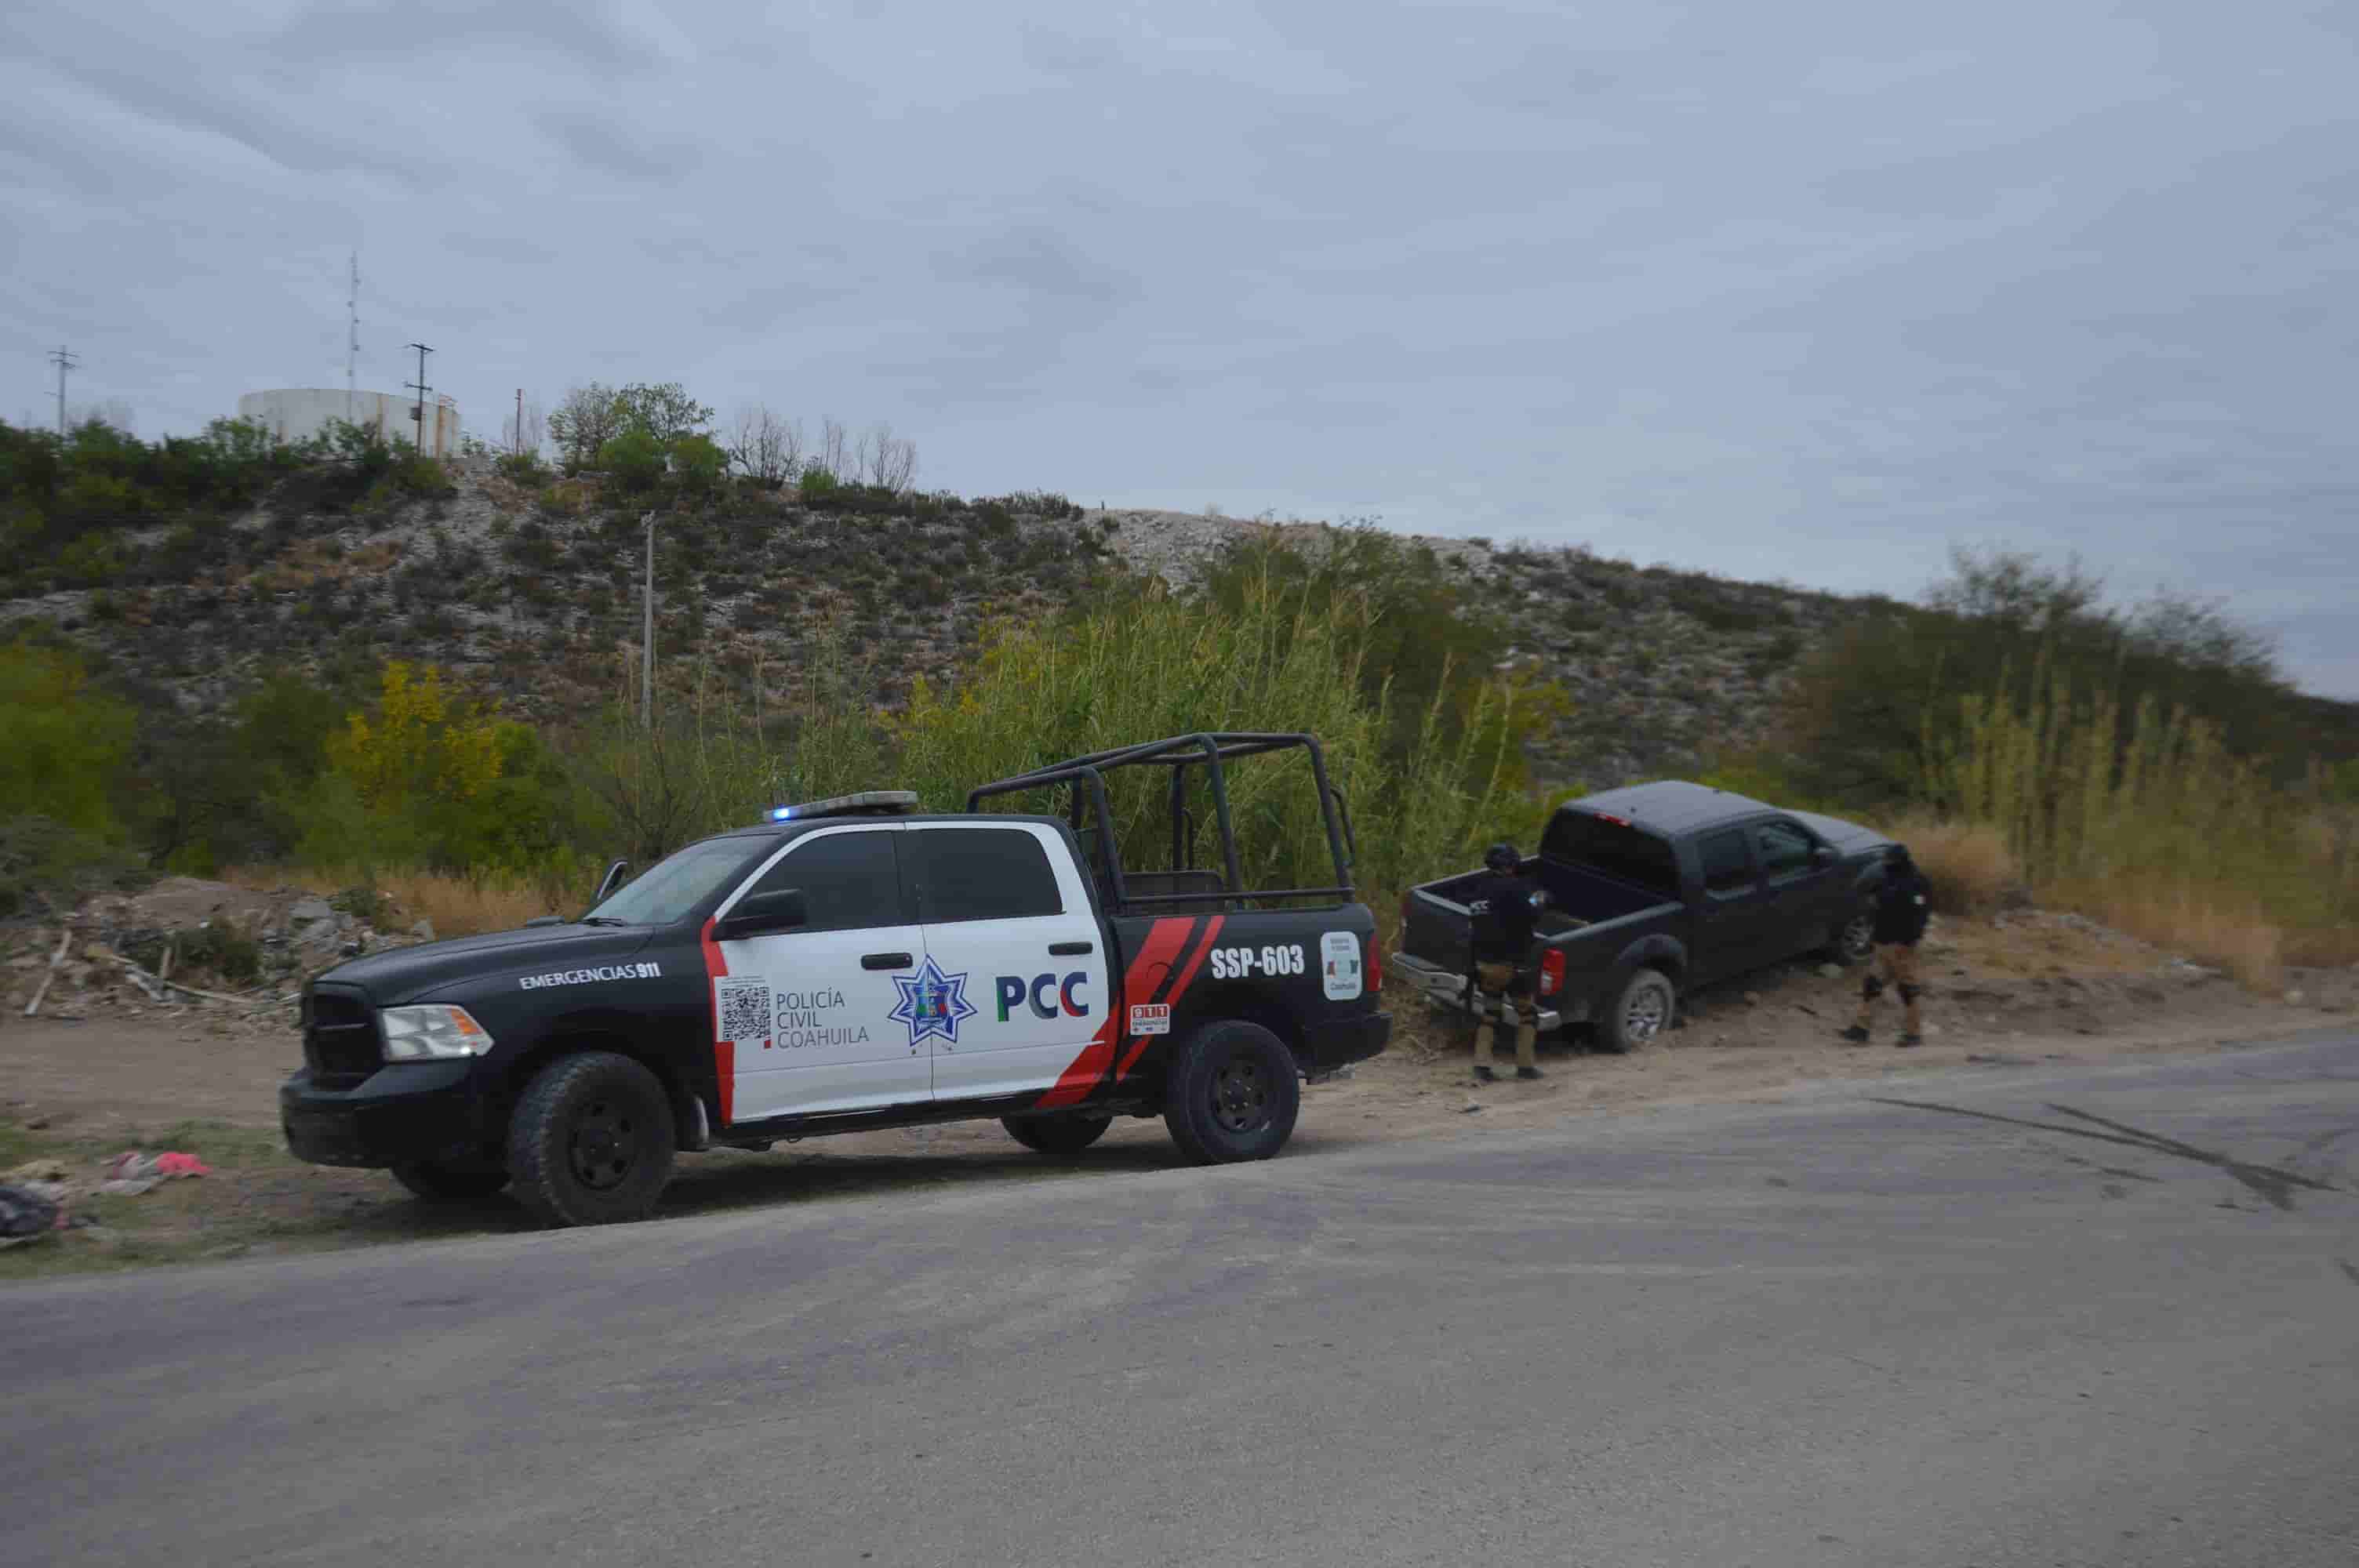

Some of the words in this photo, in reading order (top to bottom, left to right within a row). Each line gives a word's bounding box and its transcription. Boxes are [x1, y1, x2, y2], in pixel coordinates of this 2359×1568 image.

[1210, 944, 1305, 979] SSP-603
[519, 964, 636, 989] EMERGENCIAS
[636, 962, 661, 978] 911
[776, 987, 845, 1011] POLICÍA
[995, 971, 1089, 1022] PCC
[776, 1011, 823, 1029] CIVIL
[1134, 1007, 1165, 1017] 911
[777, 1026, 870, 1049] COAHUILA
